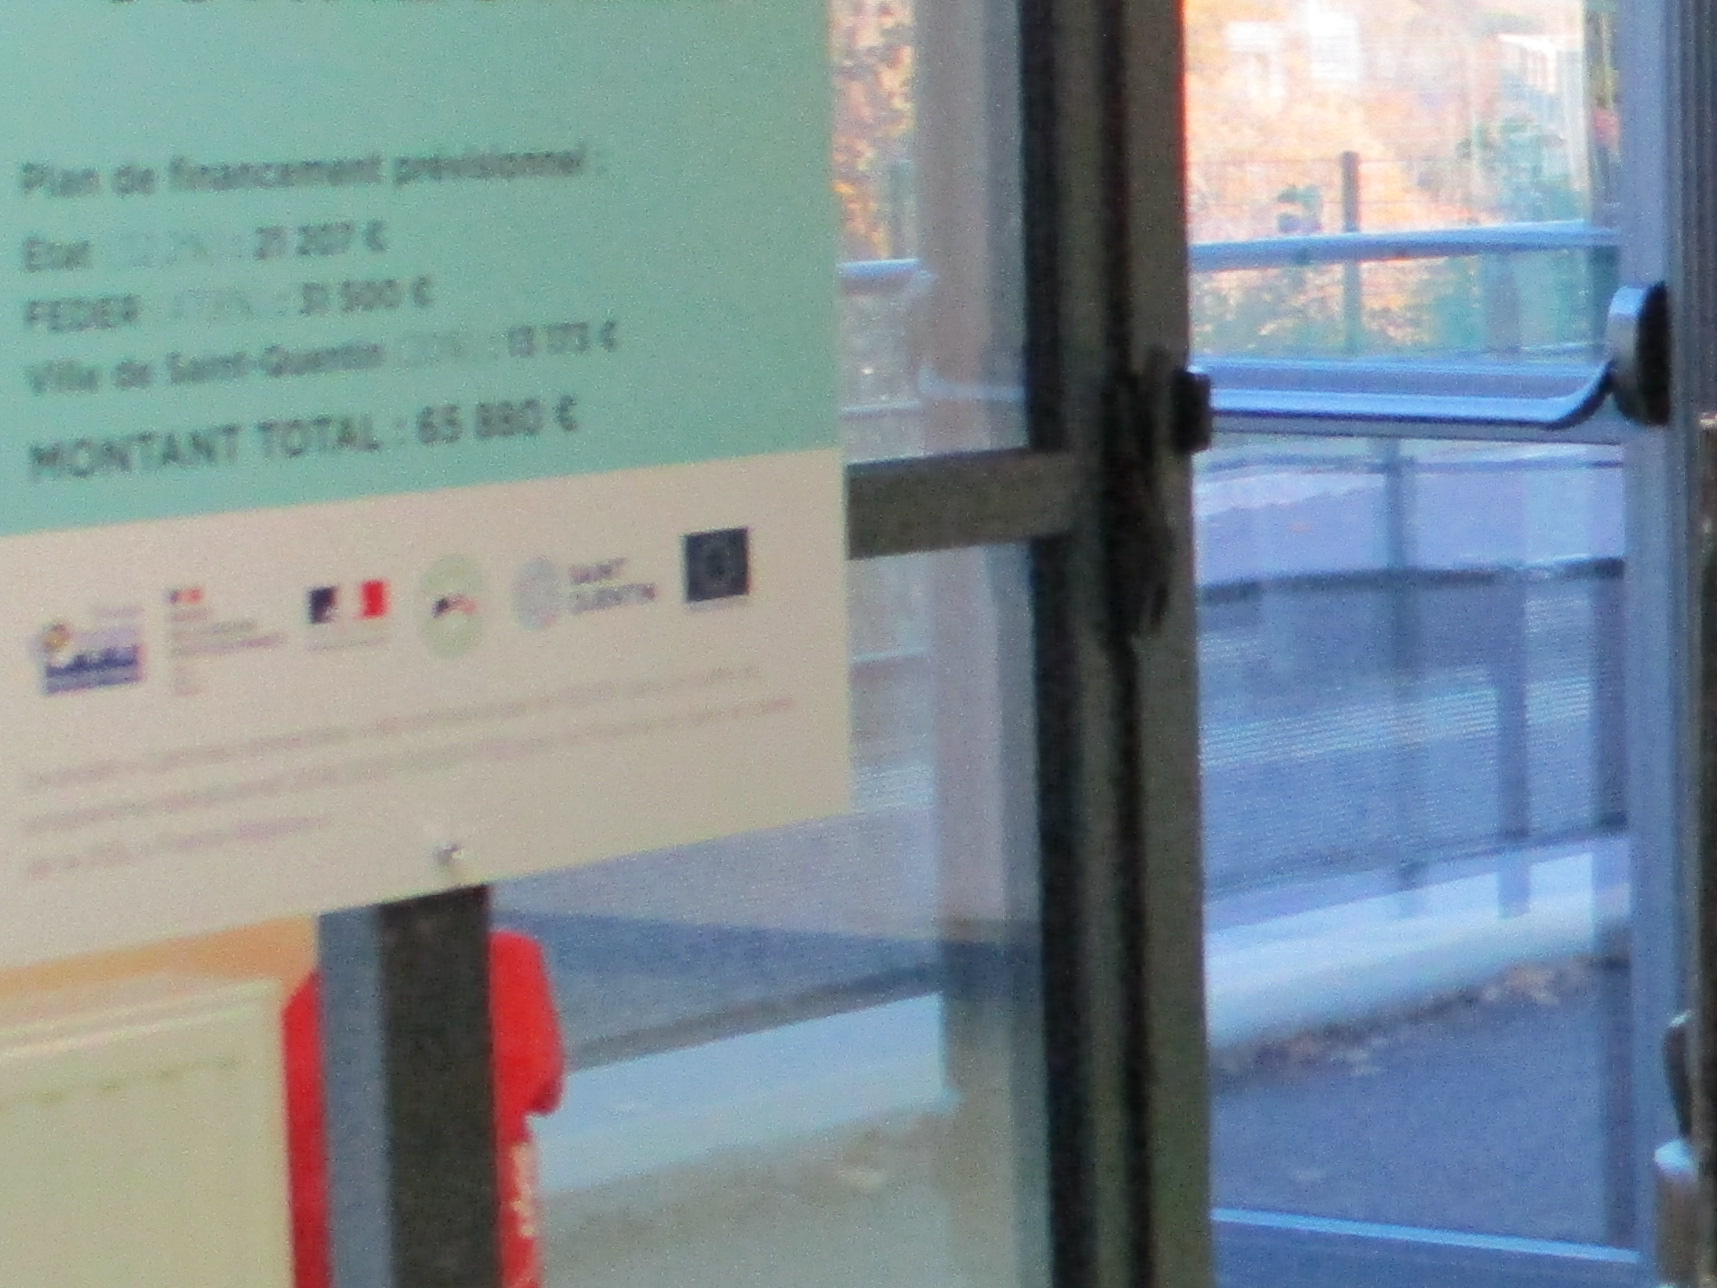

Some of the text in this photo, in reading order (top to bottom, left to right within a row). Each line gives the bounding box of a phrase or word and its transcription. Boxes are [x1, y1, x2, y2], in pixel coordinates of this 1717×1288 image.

[21, 161, 99, 196] Plan
[111, 164, 155, 197] de
[168, 155, 382, 191] financement
[363, 218, 387, 253] €
[24, 294, 141, 332] FEDER
[410, 274, 434, 309] €
[27, 360, 101, 393] Ville
[112, 359, 153, 390] de
[165, 343, 384, 385] Saint-Quentin
[28, 423, 243, 479] MONTANT
[253, 414, 384, 458] TOTAL
[416, 404, 463, 444] 65
[473, 397, 545, 441] 880
[552, 393, 579, 432] €
